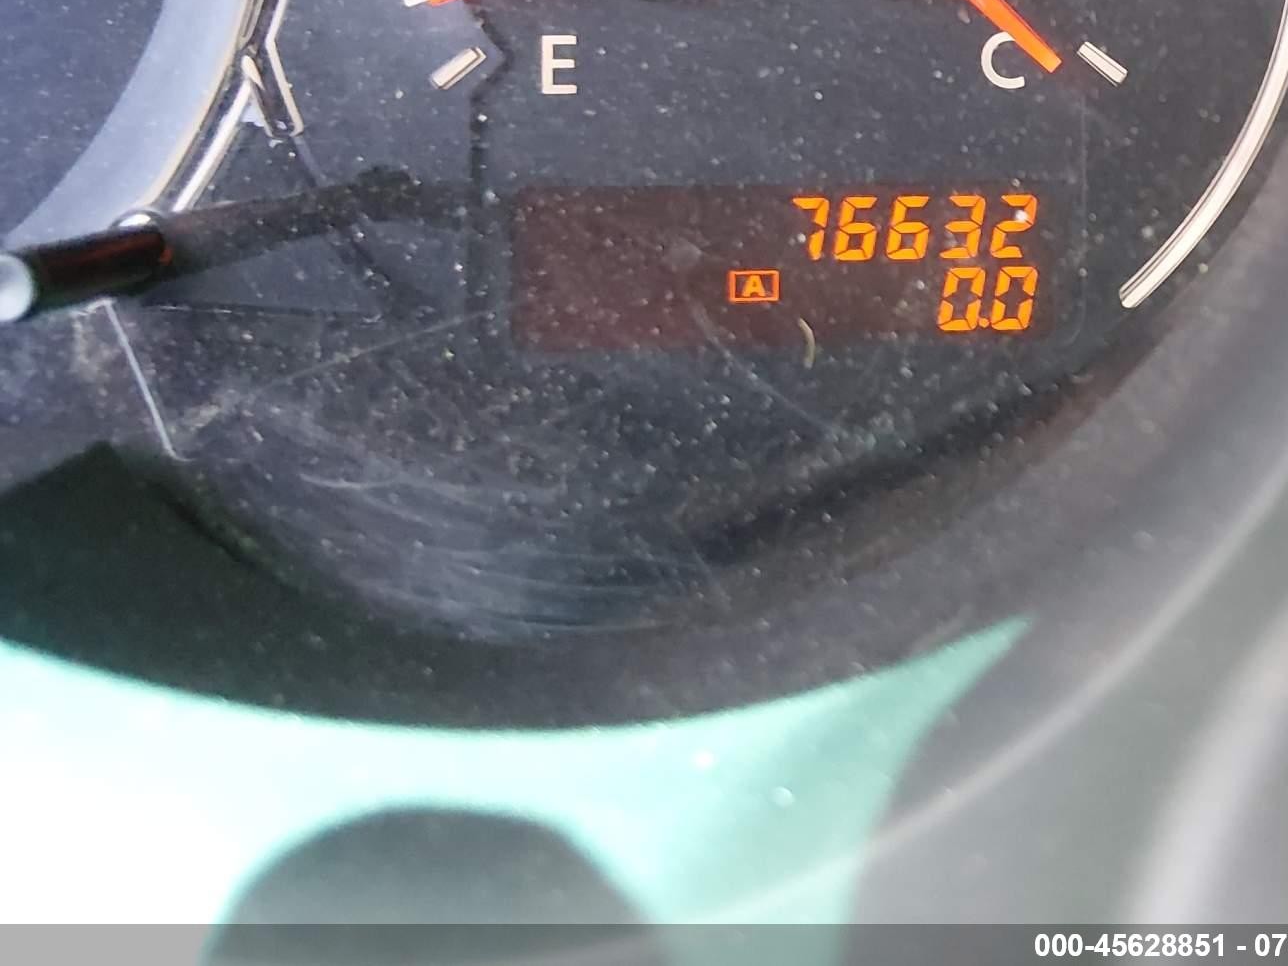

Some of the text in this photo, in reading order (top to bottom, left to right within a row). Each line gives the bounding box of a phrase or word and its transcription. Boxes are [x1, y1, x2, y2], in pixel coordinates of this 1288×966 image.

[537, 34, 578, 95] E
[980, 31, 1026, 90] C
[792, 193, 1038, 262] 76632
[741, 265, 1039, 332] A 0.0
